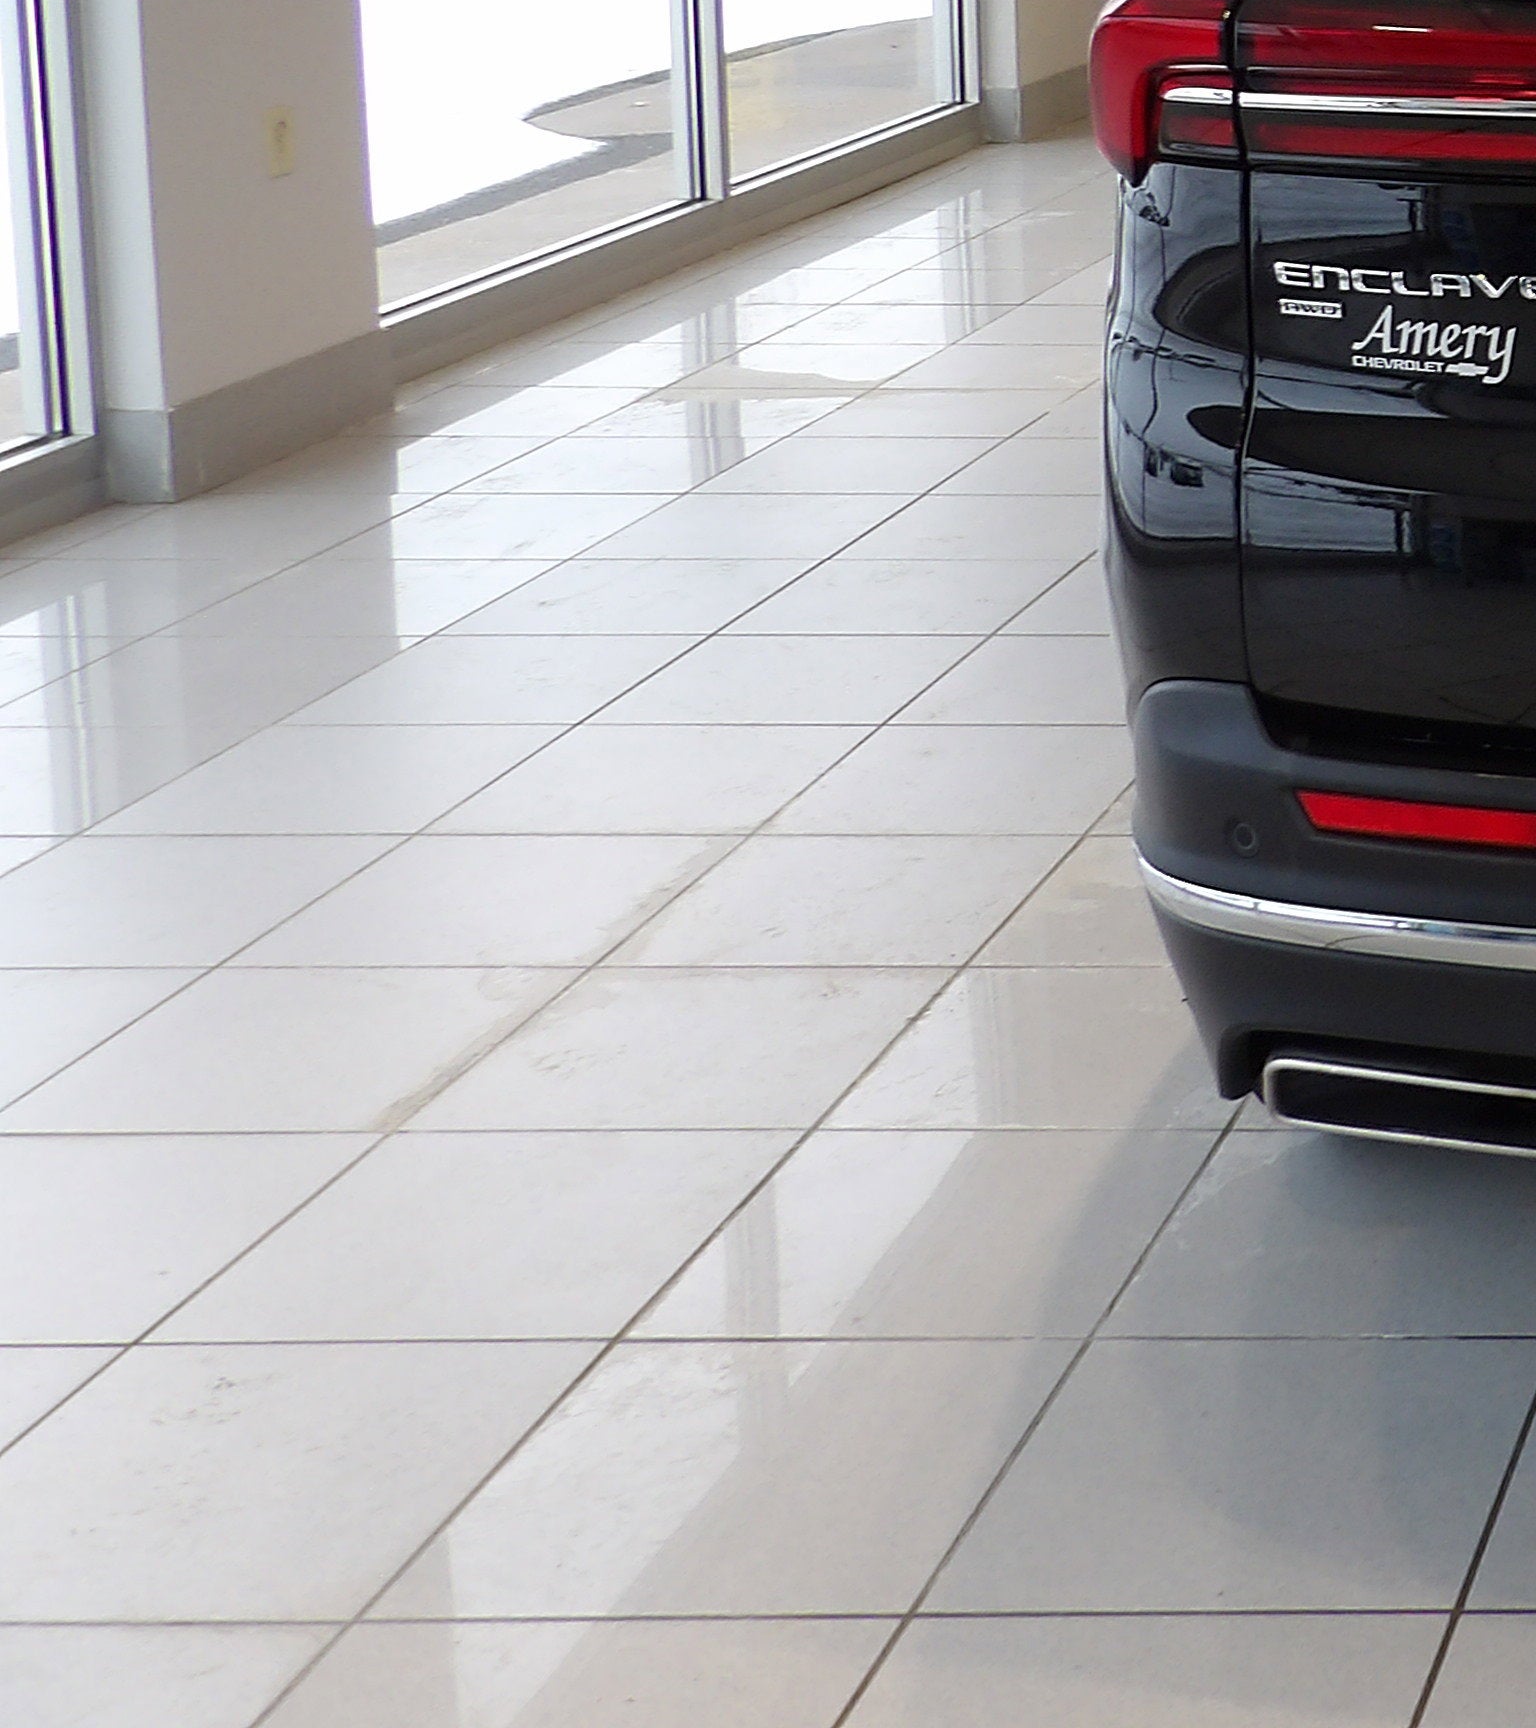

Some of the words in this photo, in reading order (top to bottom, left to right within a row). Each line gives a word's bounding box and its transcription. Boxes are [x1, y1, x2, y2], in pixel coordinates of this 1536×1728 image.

[1283, 301, 1339, 317] AWD
[1351, 304, 1518, 385] Amery
[1351, 354, 1446, 374] CHEVROLET
